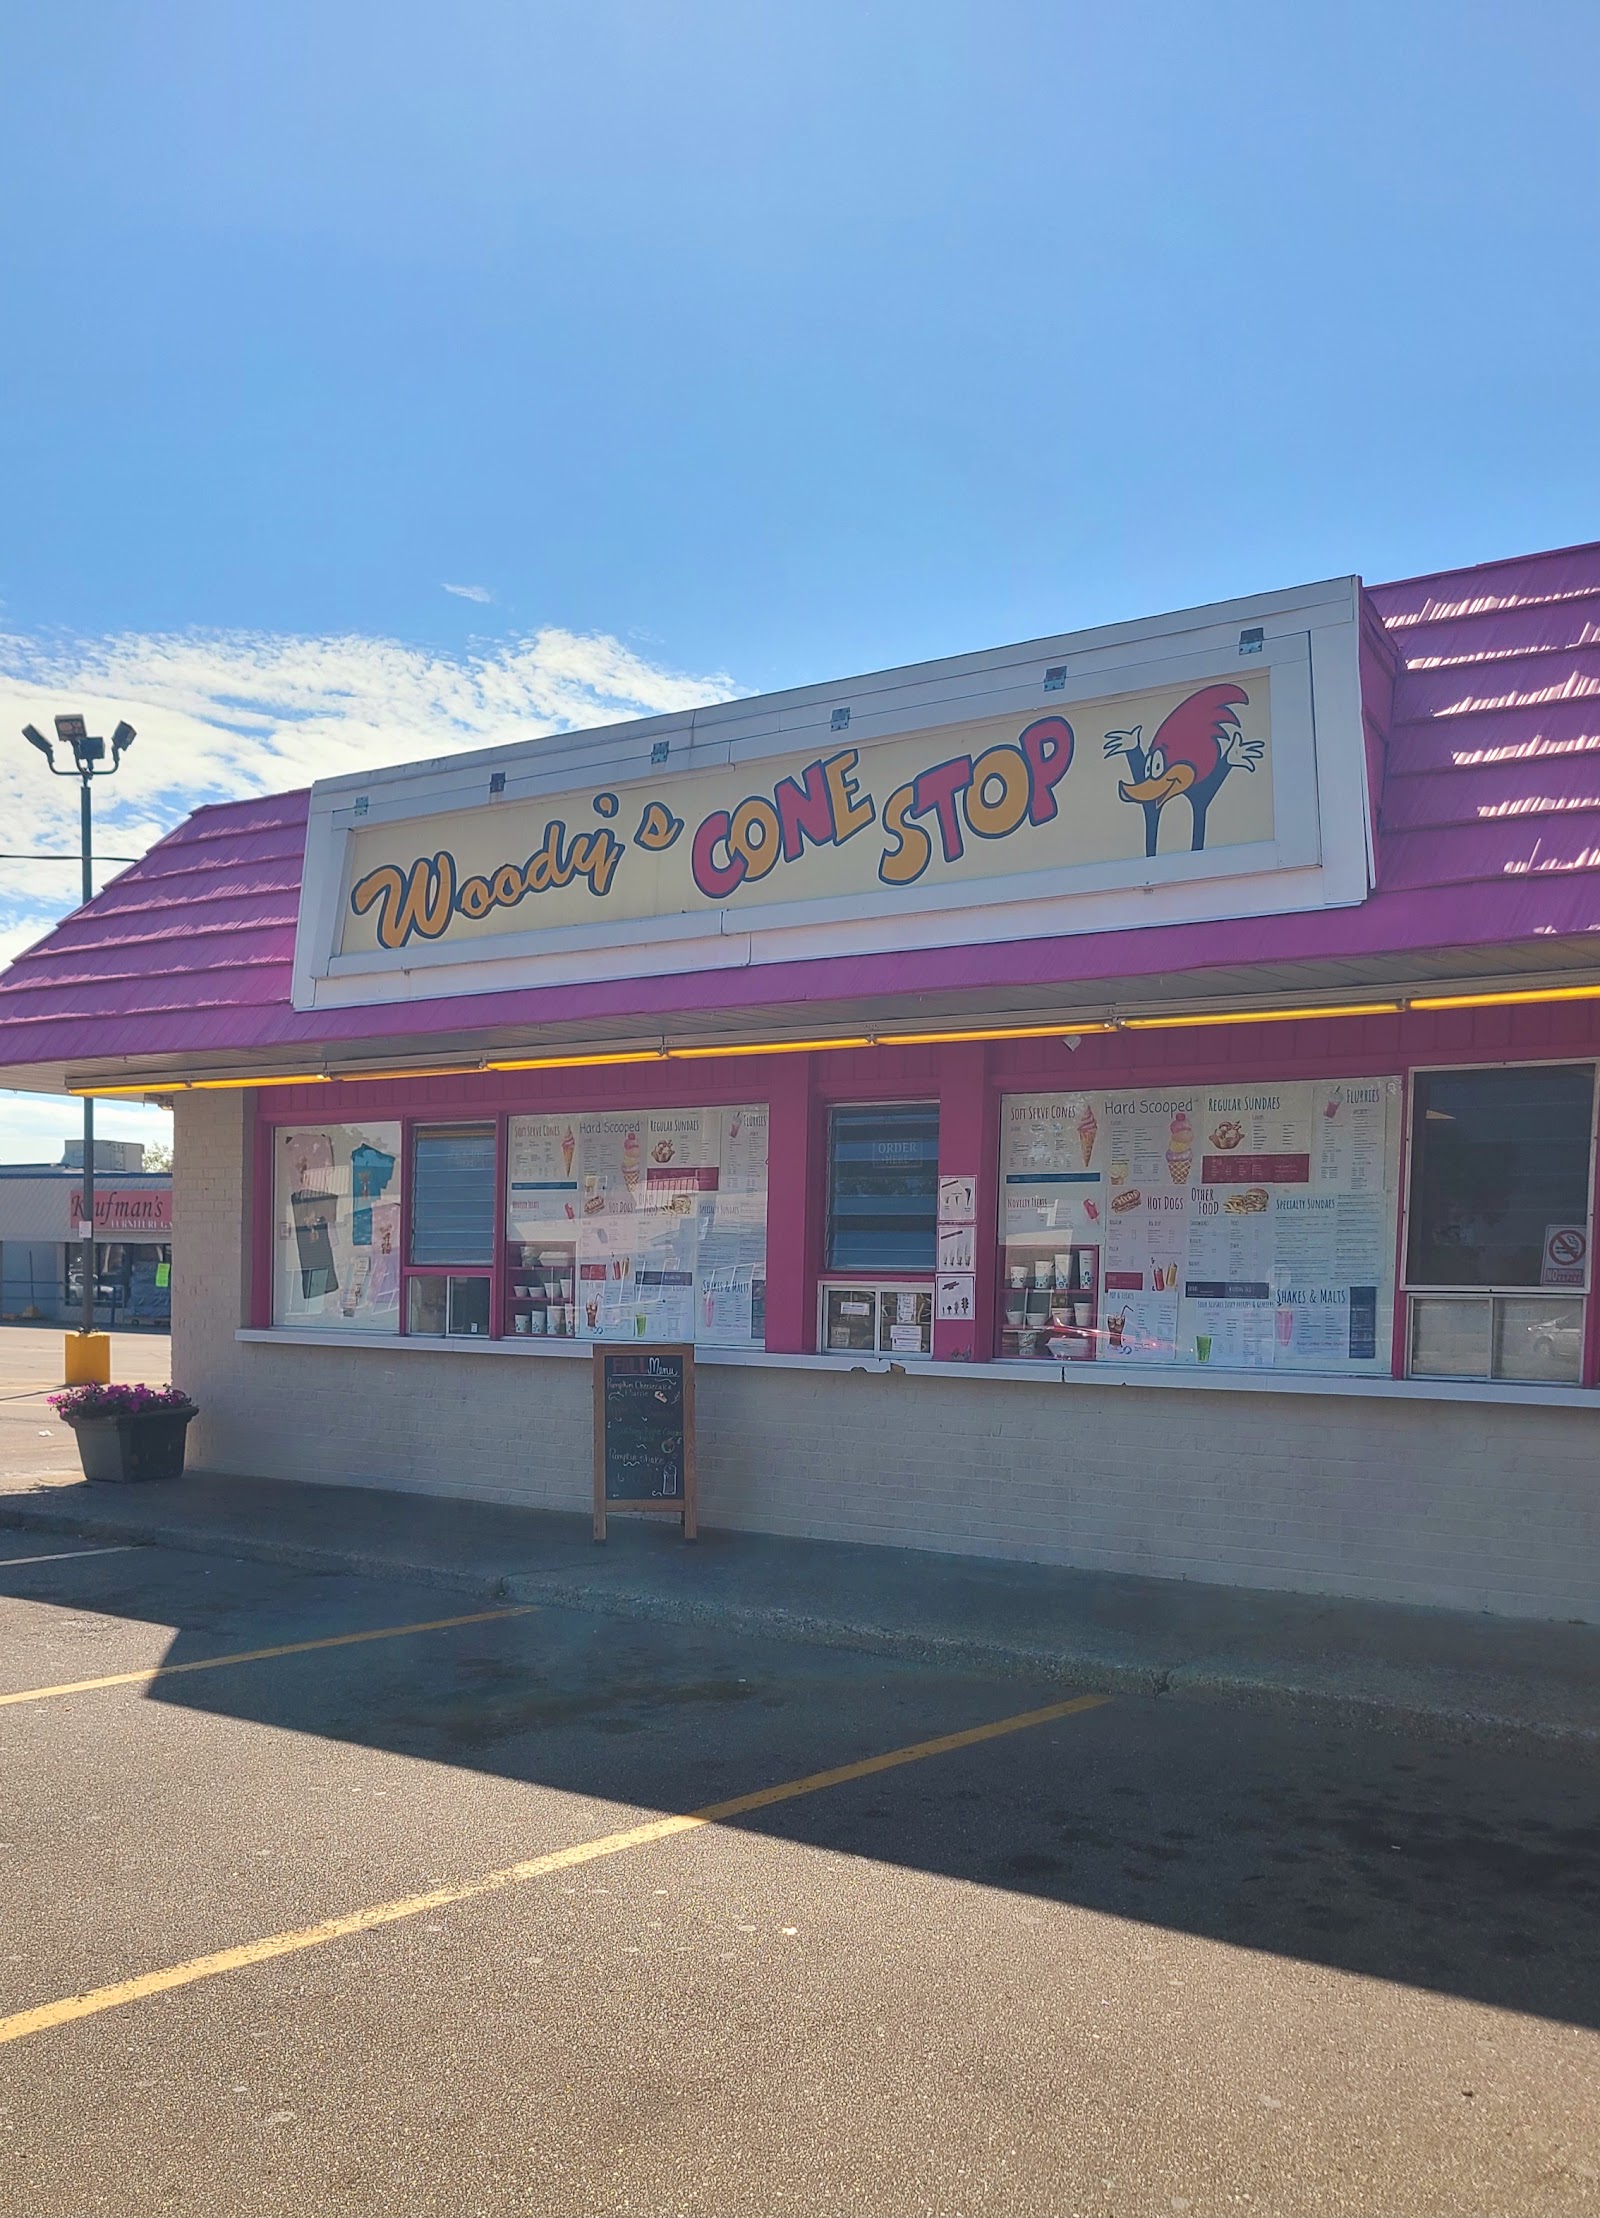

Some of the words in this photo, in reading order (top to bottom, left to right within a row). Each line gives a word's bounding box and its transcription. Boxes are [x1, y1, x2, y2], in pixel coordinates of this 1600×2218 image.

[351, 793, 683, 949] Woody's
[691, 748, 875, 899] CONE
[878, 715, 1076, 886] STOP
[1104, 1101, 1135, 1115] Hard
[1139, 1099, 1193, 1118] Scooped
[1208, 1098, 1242, 1112] REGULAR
[1244, 1096, 1280, 1111] SUNDAES
[1010, 1107, 1026, 1121] SOFT
[1028, 1106, 1049, 1120] SERVE
[1051, 1105, 1076, 1119] CONES
[527, 1125, 542, 1137] SERVE
[579, 1121, 601, 1134] Hard
[603, 1120, 640, 1137] Scooped
[650, 1120, 674, 1132] REGULAR
[674, 1119, 699, 1132] SUNDAES
[878, 1142, 917, 1154] ORDER
[1191, 1187, 1214, 1202] OTHER
[71, 1191, 164, 1226] Kufman's
[1147, 1196, 1162, 1210] HOT
[1164, 1196, 1184, 1210] DOGS
[1198, 1201, 1219, 1215] FOOD
[1276, 1198, 1305, 1210] SPECIALTY
[1307, 1198, 1335, 1210] SUNDAES
[111, 1219, 157, 1229] FURNITURE
[1546, 1269, 1558, 1282] NO
[1276, 1288, 1306, 1304] SHAKES
[1309, 1289, 1317, 1304] &
[1320, 1288, 1346, 1304] MALTS
[648, 1357, 678, 1376] Menu
